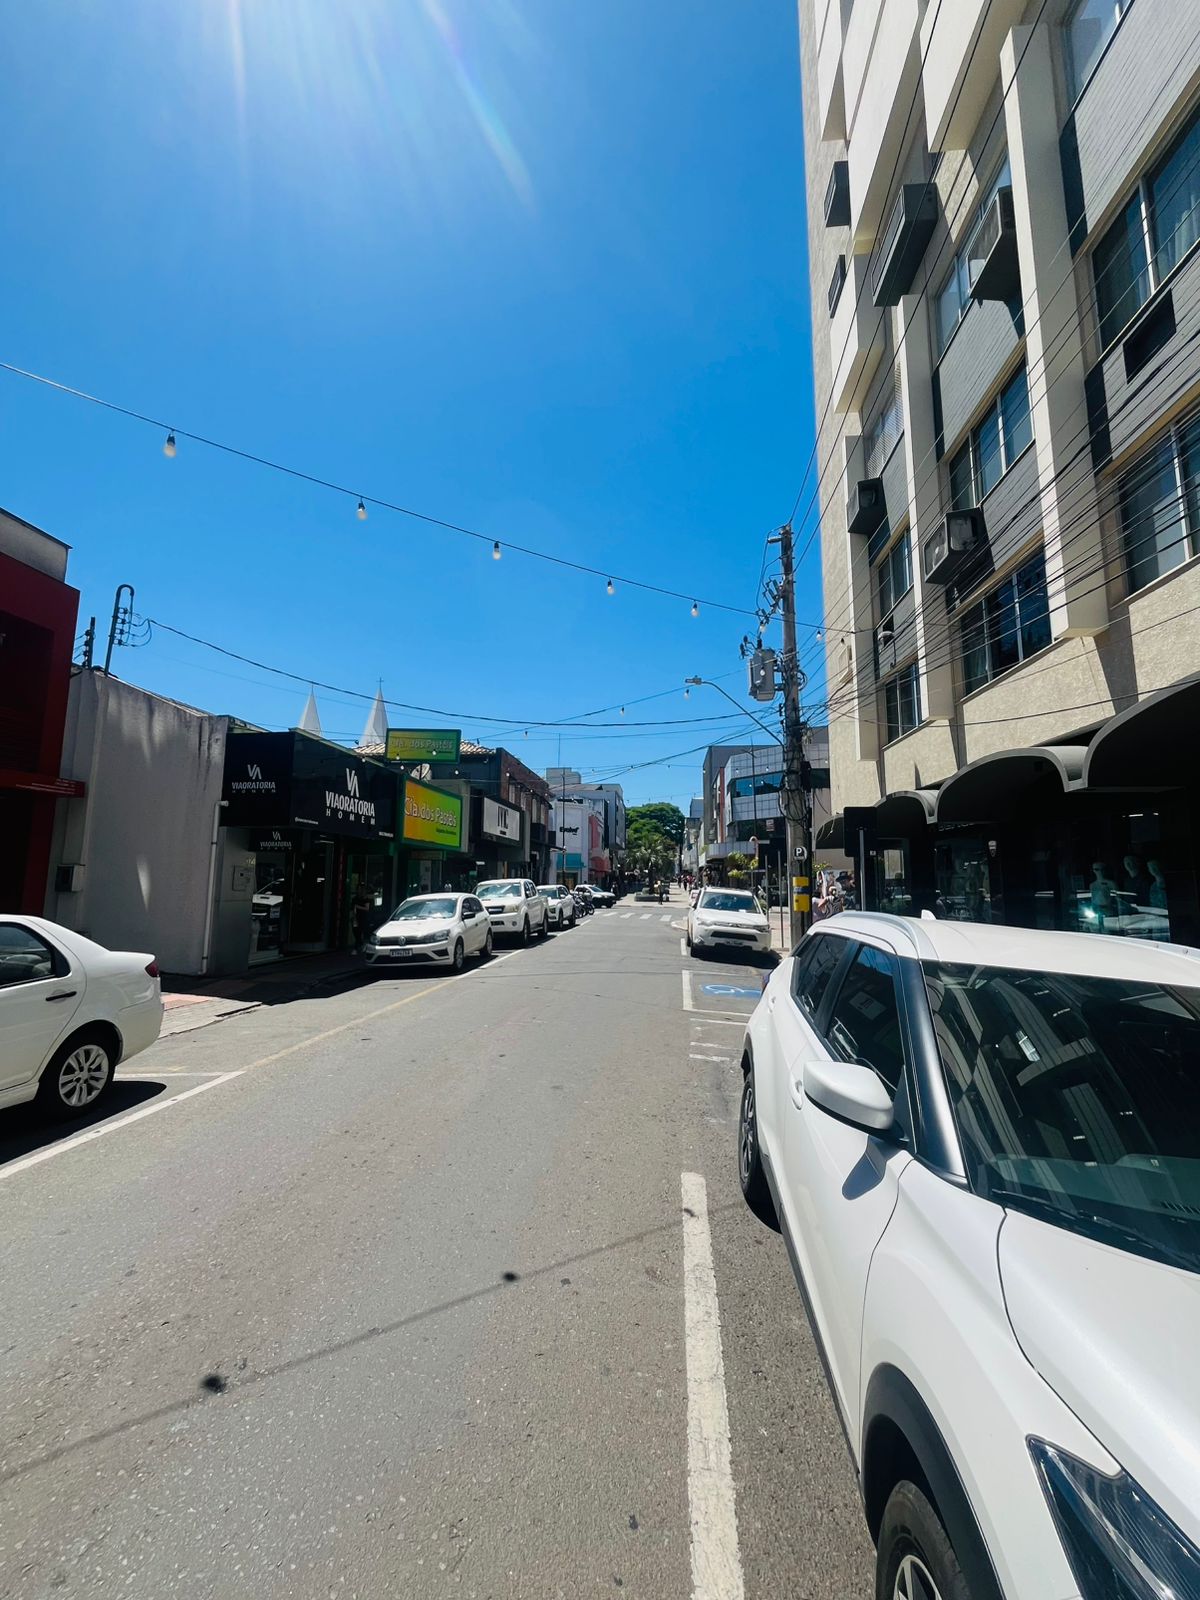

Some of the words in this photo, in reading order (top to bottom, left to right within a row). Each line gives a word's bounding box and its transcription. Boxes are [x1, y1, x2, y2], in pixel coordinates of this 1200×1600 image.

[231, 781, 276, 790] VIAORATORIA
[325, 790, 375, 817] VIAORATORIA
[795, 847, 803, 857] P
